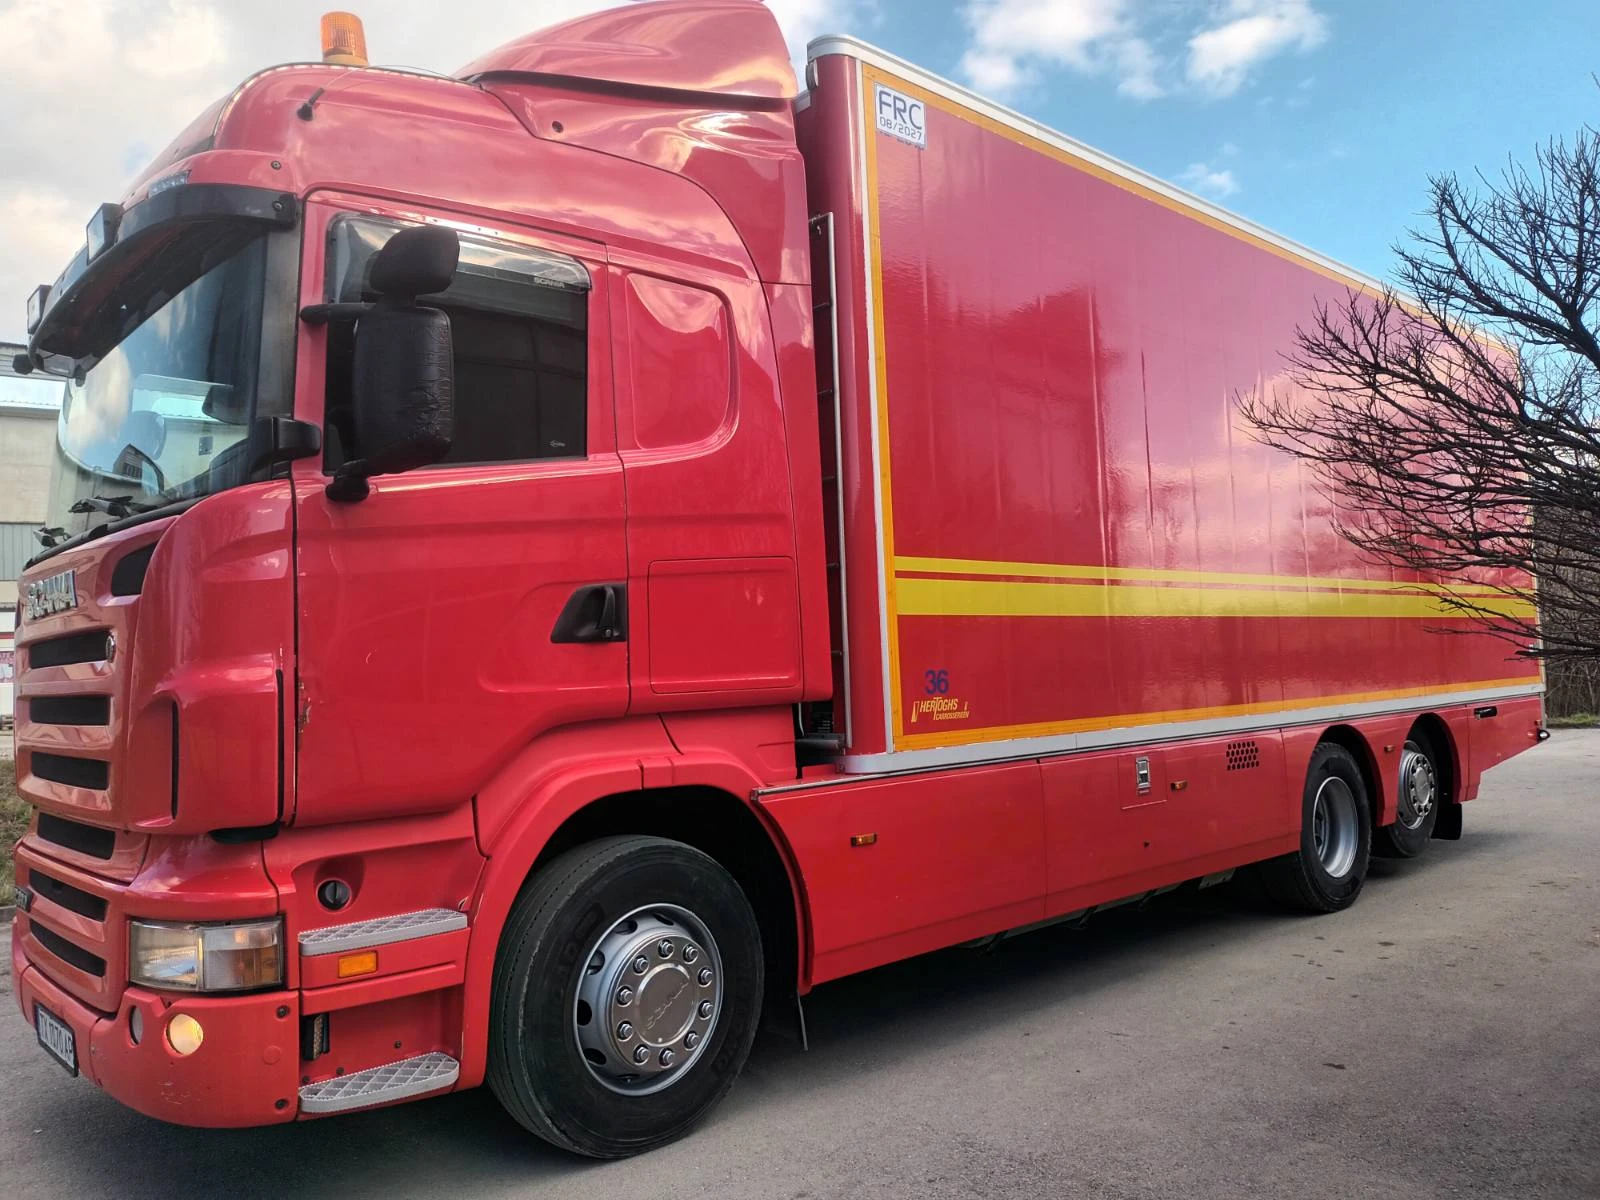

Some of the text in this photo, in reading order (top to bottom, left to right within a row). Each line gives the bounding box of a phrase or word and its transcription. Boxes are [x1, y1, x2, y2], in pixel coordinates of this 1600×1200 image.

[879, 90, 922, 130] FRC
[880, 116, 922, 141] 08/2027
[925, 669, 949, 694] 36
